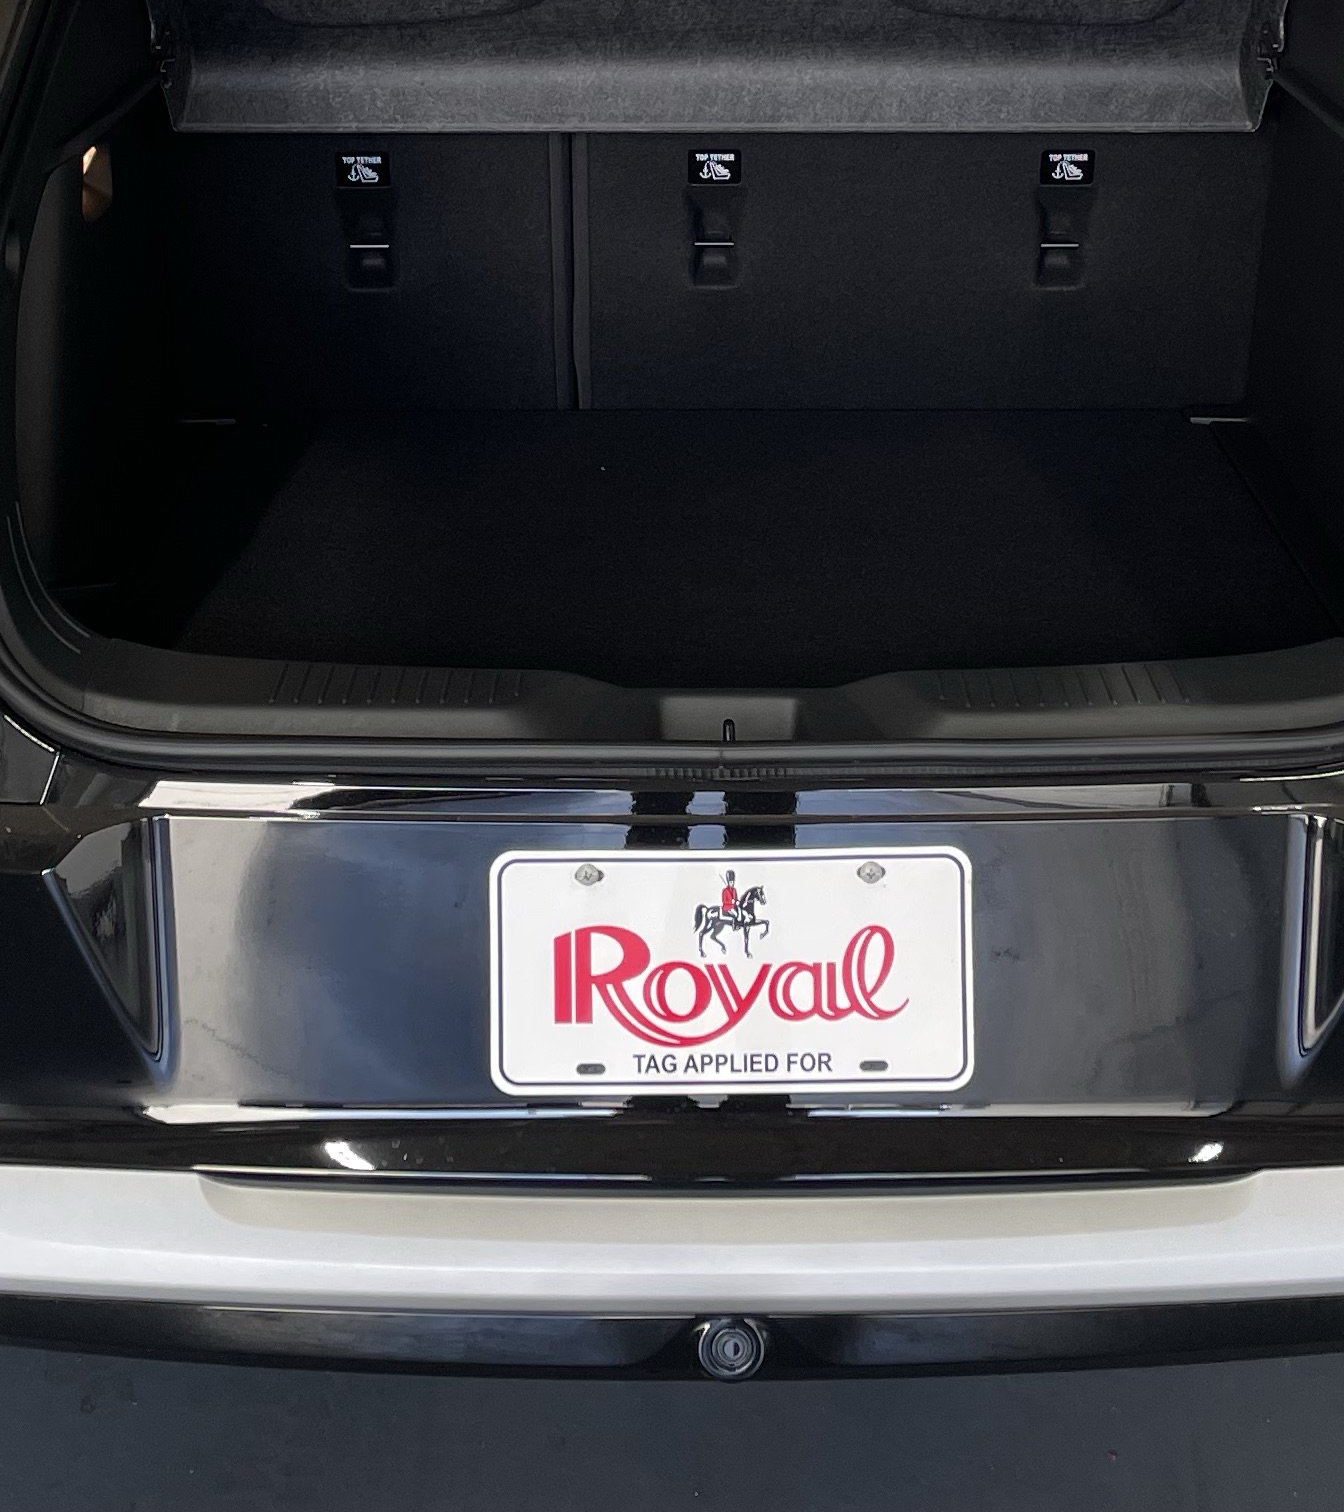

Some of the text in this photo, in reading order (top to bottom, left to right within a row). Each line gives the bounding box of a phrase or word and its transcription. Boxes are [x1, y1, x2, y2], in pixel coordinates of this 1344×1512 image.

[696, 153, 709, 161] TOP
[1049, 153, 1062, 161] TOP
[553, 924, 910, 1048] Royal
[632, 1052, 833, 1074] TAG APPLIED FOR
